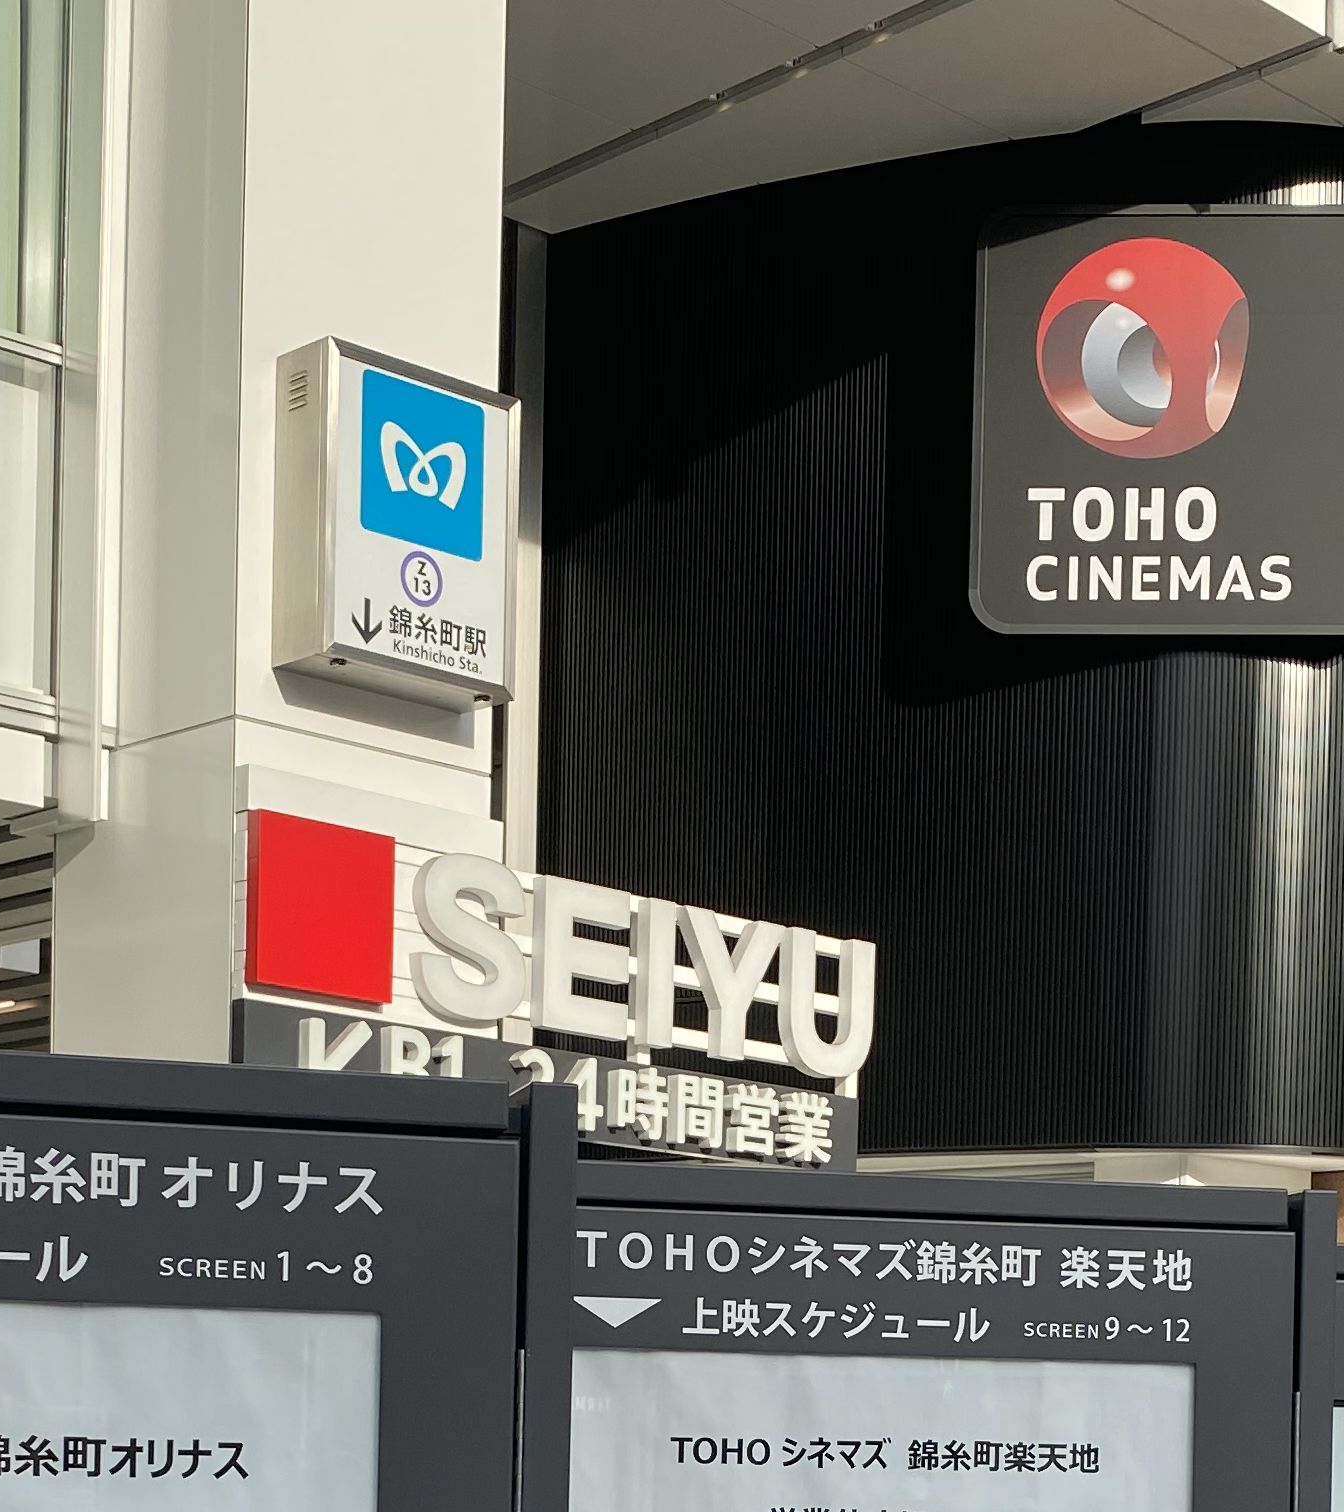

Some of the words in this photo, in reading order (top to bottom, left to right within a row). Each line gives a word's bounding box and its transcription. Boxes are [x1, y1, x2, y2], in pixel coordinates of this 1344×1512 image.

[1027, 486, 1217, 542] TOHO
[413, 577, 432, 596] 13
[417, 560, 427, 576] Z
[1026, 554, 1293, 602] CINEMAS
[389, 604, 487, 659] 錦糸町駅
[393, 638, 455, 667] Kinshicho
[459, 656, 483, 675] Sta.
[410, 851, 878, 1081] SEIYU
[160, 1153, 385, 1216] オリナス
[159, 1255, 267, 1281] SCREEN
[1060, 1246, 1194, 1293] 楽天地
[682, 1297, 990, 1344] 上映スケジュール
[1023, 1320, 1099, 1340] SCREEN
[669, 1435, 772, 1467] TOHO
[781, 1436, 892, 1470] シネマズ
[907, 1440, 1100, 1473] 錦糸町楽天地
